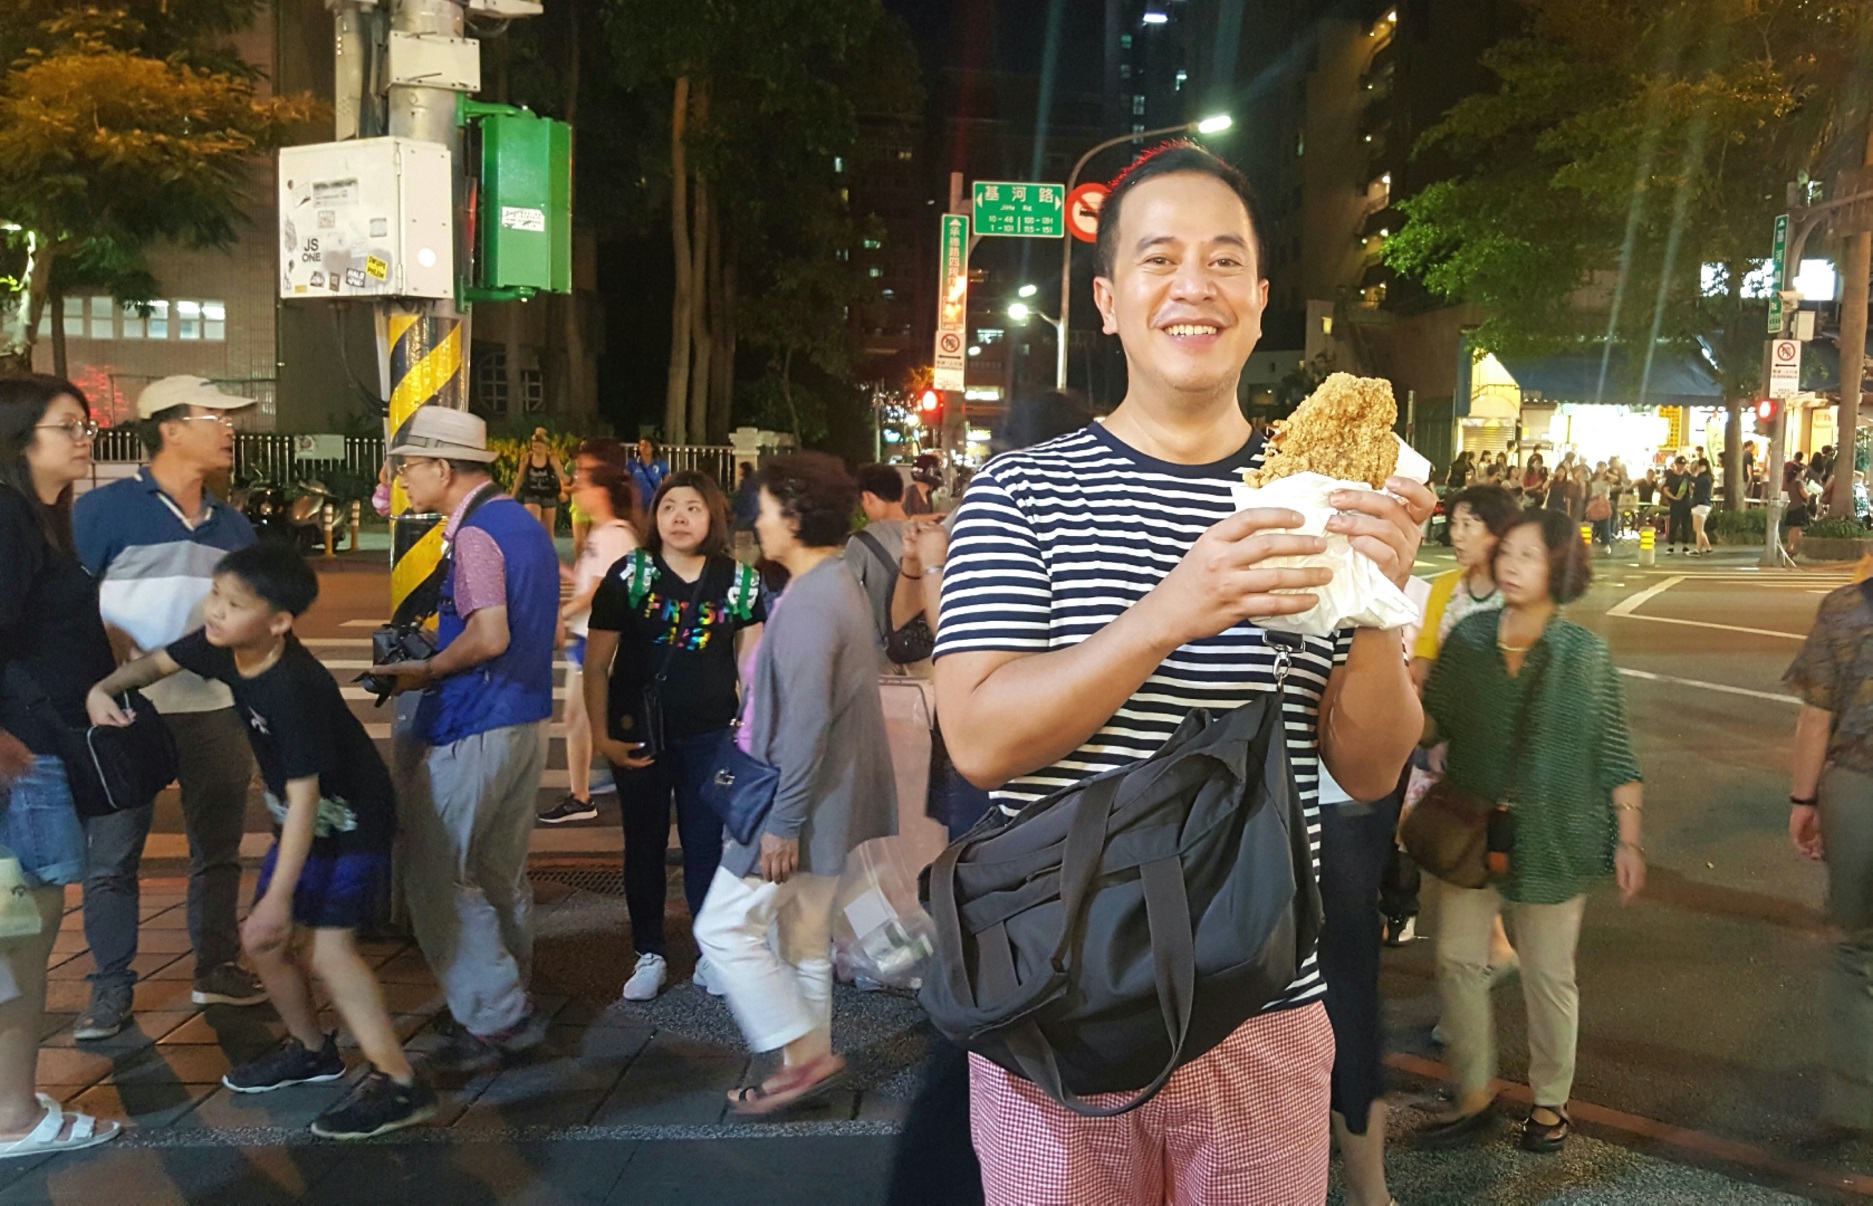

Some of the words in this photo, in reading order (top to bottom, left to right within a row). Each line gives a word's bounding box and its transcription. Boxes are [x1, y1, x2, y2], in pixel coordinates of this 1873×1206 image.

[985, 186, 1053, 203] 基河路
[304, 239, 319, 251] JS
[302, 253, 321, 262] ONE
